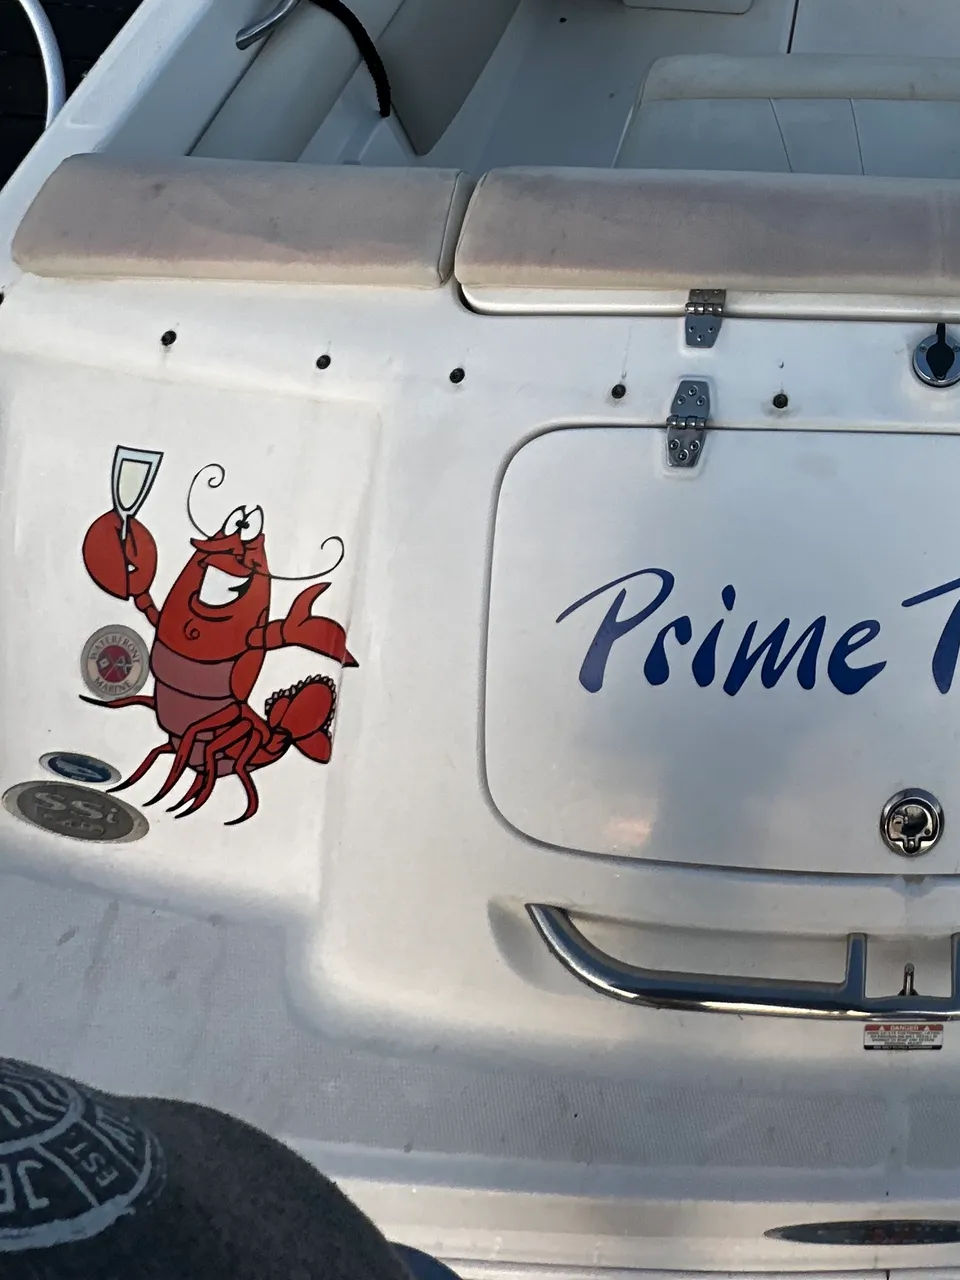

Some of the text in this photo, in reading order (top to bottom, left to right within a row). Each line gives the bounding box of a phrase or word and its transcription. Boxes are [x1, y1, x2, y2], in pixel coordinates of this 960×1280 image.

[556, 567, 887, 697] Prime
[88, 634, 141, 663] WATERFRONT
[94, 676, 131, 694] MARINE
